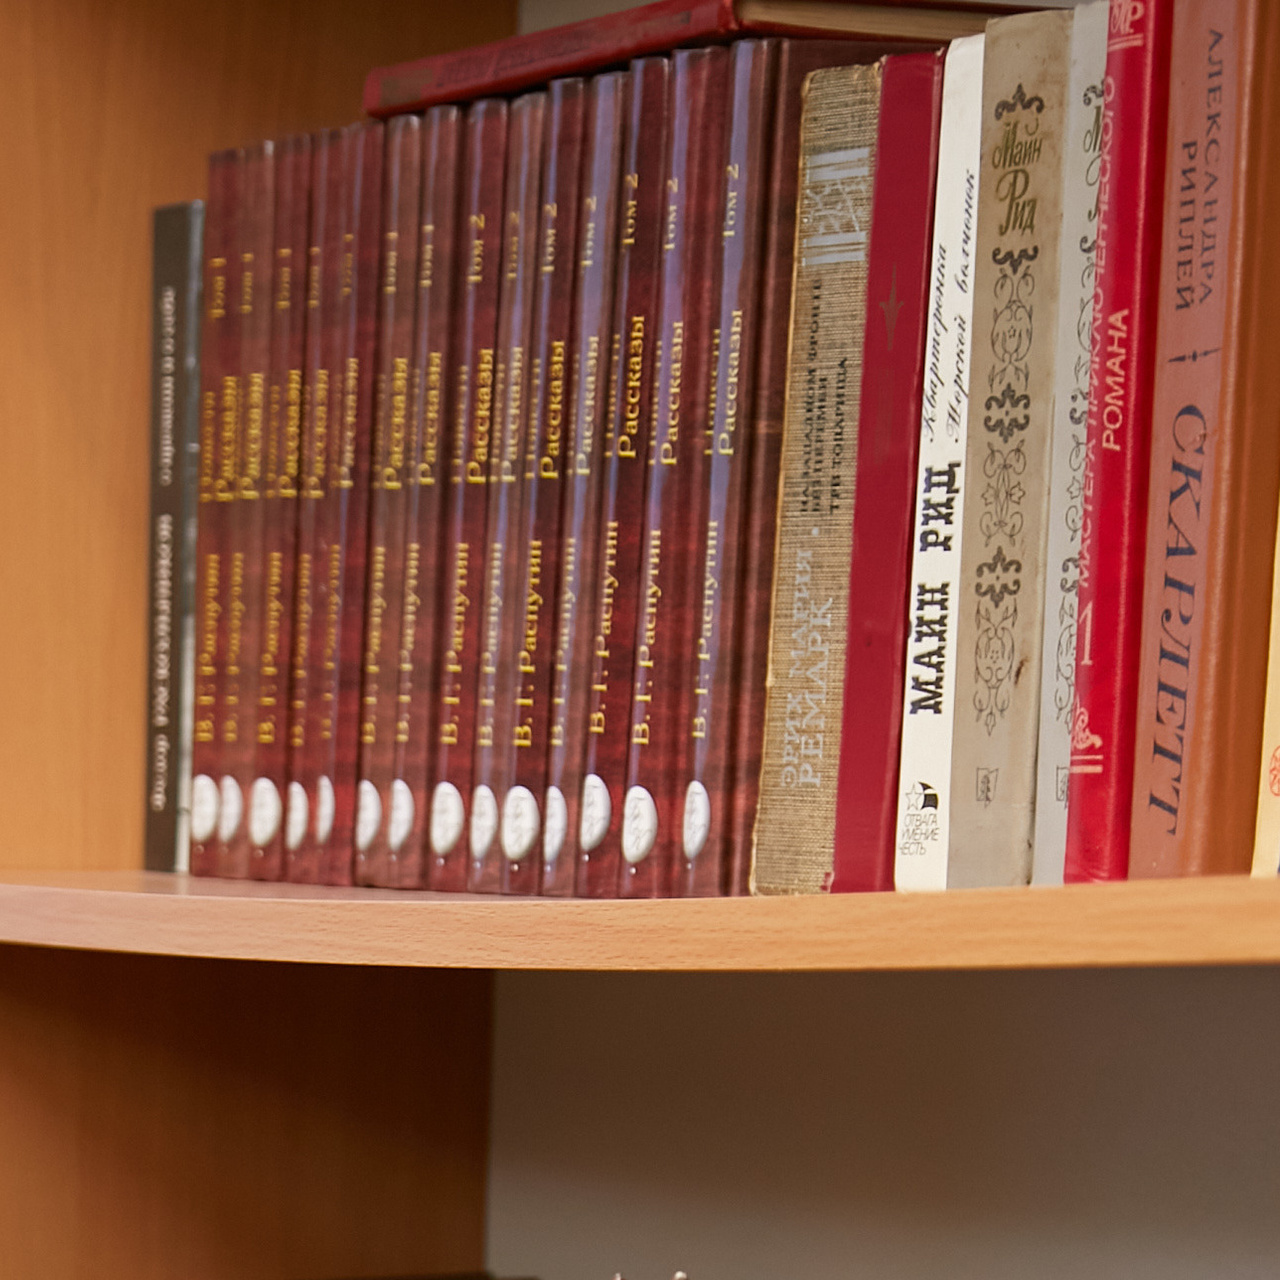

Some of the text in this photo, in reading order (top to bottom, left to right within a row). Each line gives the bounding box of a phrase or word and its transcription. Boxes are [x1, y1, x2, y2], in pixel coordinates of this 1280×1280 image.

[992, 119, 1043, 170] Майн
[996, 169, 1037, 236] Рид
[1198, 28, 1225, 305] АЛЕКСАНДРА
[1175, 140, 1198, 312] РИПЛЕЙ
[922, 244, 948, 443] Квартеронка
[946, 170, 977, 443] Морской волчонок
[539, 341, 565, 480] Рассказы
[575, 336, 599, 476] Рассказы
[617, 315, 645, 458] Рассказы
[659, 321, 684, 465] Рассказы
[717, 309, 743, 456] Рассказы
[1102, 308, 1129, 451] РОМАНА
[920, 462, 959, 551] РИД
[1078, 438, 1098, 588] МАСТЕРА
[517, 539, 543, 673] Распутин
[555, 537, 576, 671] Распутин
[595, 521, 619, 658] Распутин
[637, 529, 662, 667] Распутин
[697, 520, 718, 661] Распутин
[1148, 404, 1207, 835] СКАРЛЕТТ
[512, 716, 533, 747] В.
[551, 716, 565, 746] В.
[589, 703, 606, 735] В.
[631, 714, 650, 745] В.
[692, 707, 708, 739] В.
[781, 549, 812, 787] ЭРИХ МАРИЯ
[799, 597, 833, 787] РЕМАРК
